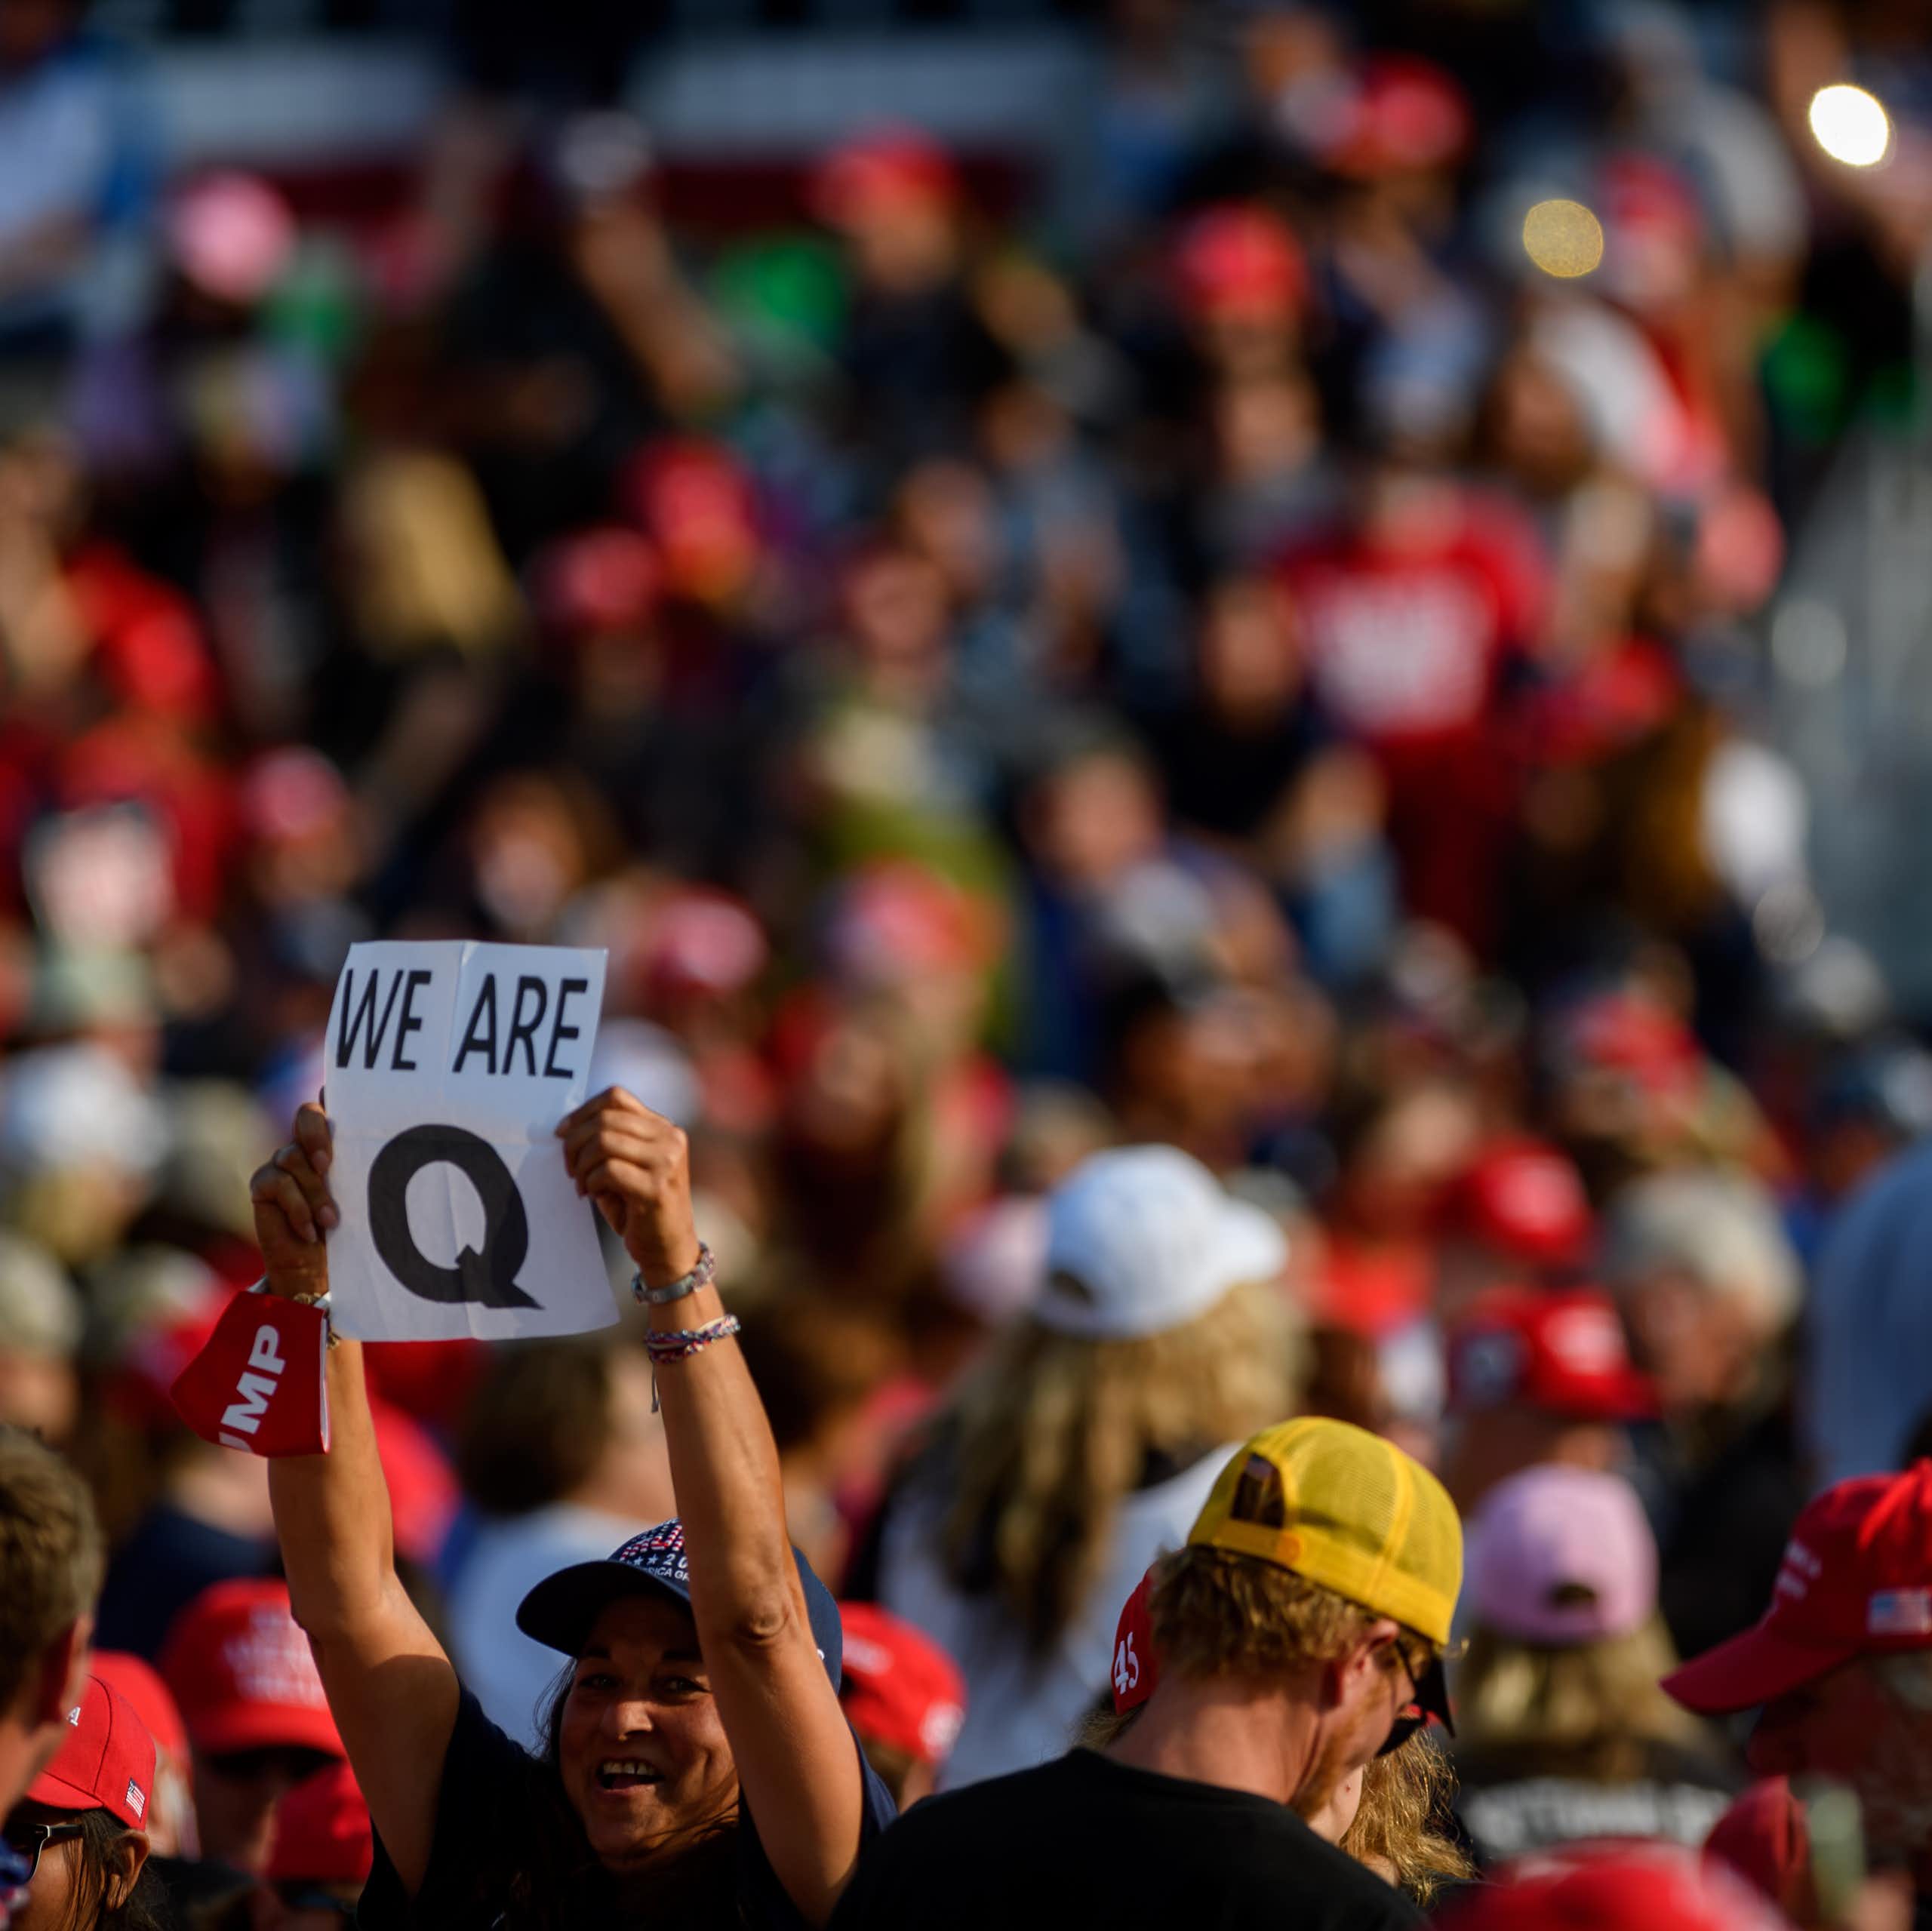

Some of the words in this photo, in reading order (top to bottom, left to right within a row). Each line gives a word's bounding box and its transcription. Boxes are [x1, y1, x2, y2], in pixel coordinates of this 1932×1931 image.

[336, 968, 432, 1071] WE
[453, 973, 588, 1079] ARE
[368, 1124, 546, 1311] Q
[1114, 1631, 1139, 1695] 45
